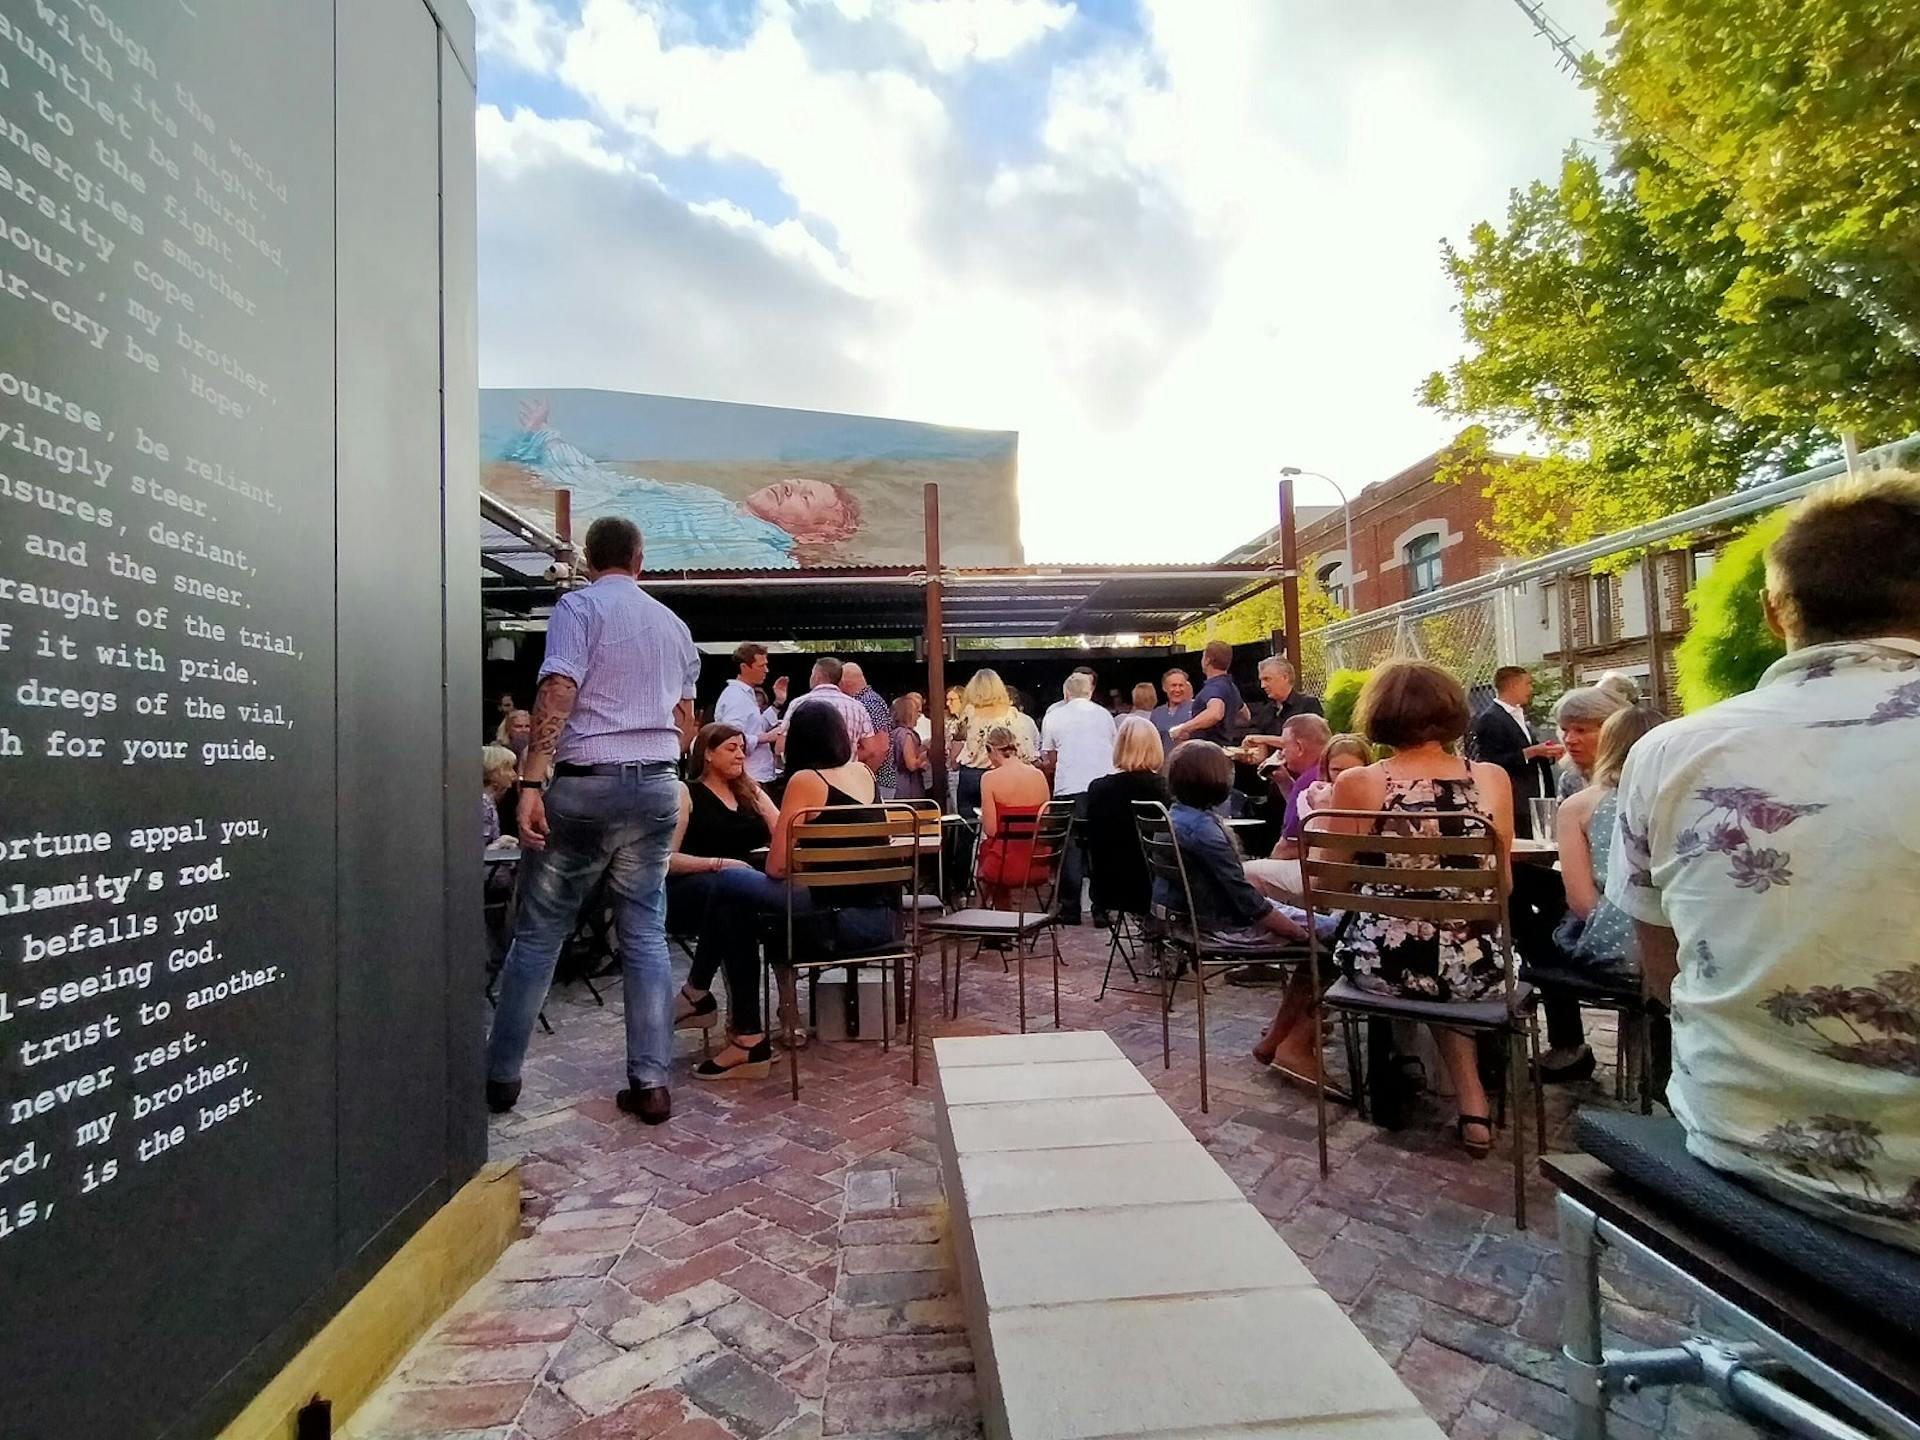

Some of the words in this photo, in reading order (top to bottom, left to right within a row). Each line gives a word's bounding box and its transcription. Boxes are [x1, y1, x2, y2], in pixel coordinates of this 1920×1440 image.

[36, 0, 114, 81] with
[73, 0, 158, 80] ough
[175, 81, 216, 135] the
[228, 137, 288, 204] world
[34, 89, 74, 136] to
[95, 138, 146, 194] the
[148, 136, 180, 181] be
[133, 260, 204, 319] cope.
[0, 269, 110, 350] r-cry
[125, 334, 160, 373] be
[127, 297, 161, 337] my
[176, 323, 276, 406] brother,
[0, 372, 115, 442] ourse,
[136, 427, 170, 462] be
[185, 455, 282, 517] reliant,
[131, 475, 218, 522] steer.
[25, 534, 88, 567] and
[107, 552, 157, 584] the
[174, 574, 250, 609] sneer.
[149, 521, 256, 577] defiant,
[37, 630, 78, 660] it
[96, 643, 166, 672] with
[179, 659, 258, 685] pride.
[136, 607, 168, 630] of
[185, 614, 225, 641] the
[239, 626, 304, 661] trial,
[16, 679, 117, 717] dregs
[136, 693, 169, 715] of
[185, 696, 226, 720] the
[237, 703, 294, 730] vial,
[46, 730, 106, 757] for
[121, 738, 188, 765] your
[202, 738, 276, 766] guide.
[130, 819, 207, 852] appal
[221, 818, 269, 844] you,
[179, 857, 231, 886] rod.
[22, 914, 158, 962] befalls
[174, 904, 218, 935] you
[168, 940, 223, 973] God.
[20, 1014, 121, 1067] trust
[139, 1001, 171, 1026] to
[185, 963, 286, 1010] another.
[10, 1065, 115, 1124] never
[132, 1031, 208, 1074] rest.
[76, 1111, 118, 1146] my
[133, 1055, 249, 1120] brother,
[81, 1158, 118, 1193] is
[138, 1125, 186, 1163] the
[198, 1087, 263, 1131] best.
